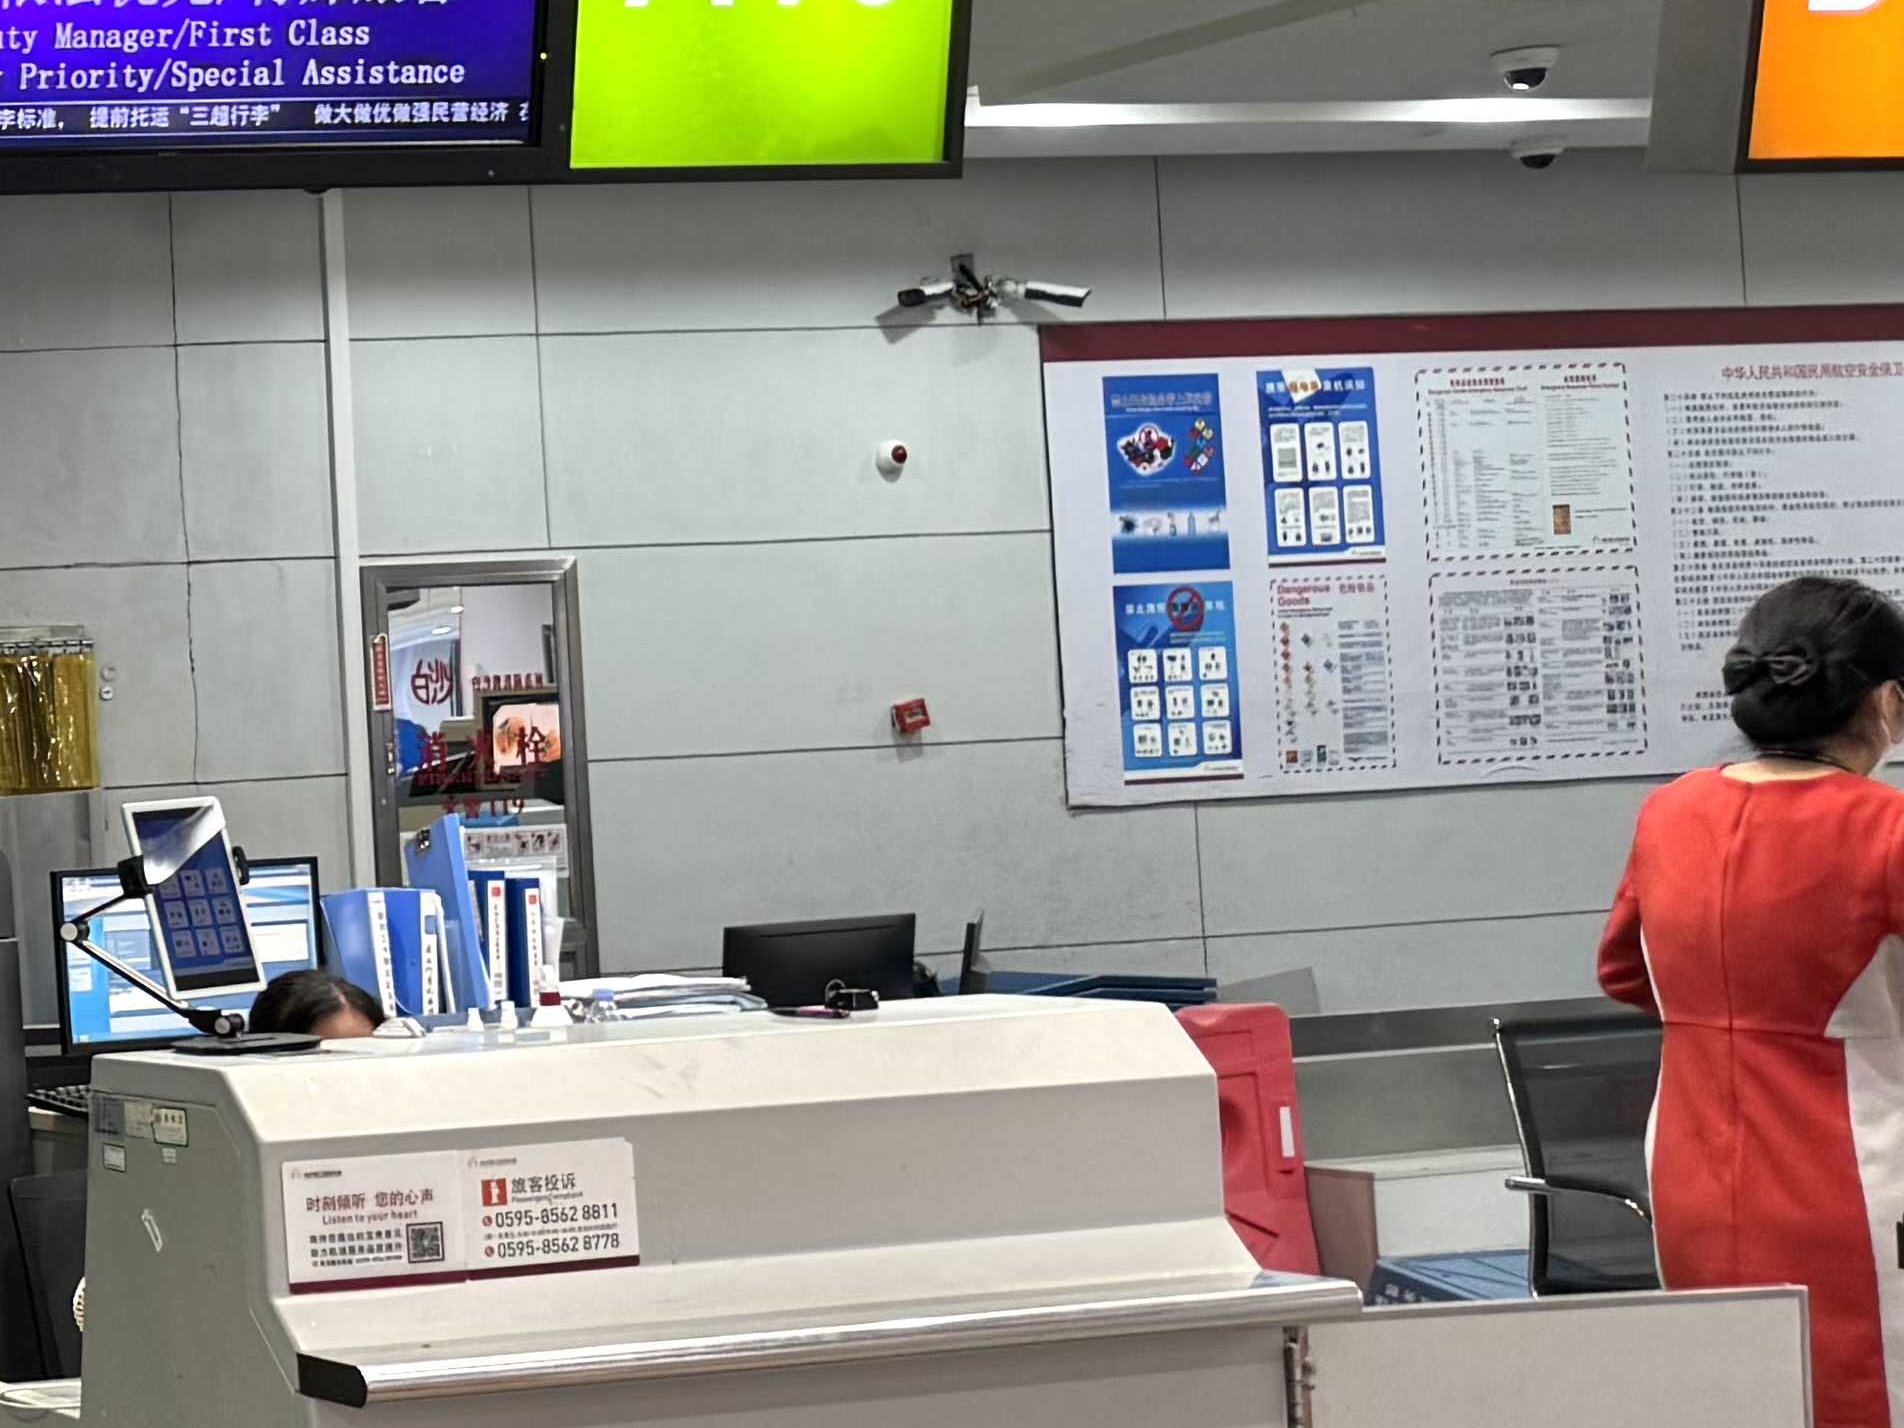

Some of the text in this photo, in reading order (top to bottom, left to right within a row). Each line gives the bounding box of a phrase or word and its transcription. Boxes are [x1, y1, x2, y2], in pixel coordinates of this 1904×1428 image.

[54, 18, 272, 53] Manager/First
[288, 18, 370, 47] Class
[19, 57, 285, 94] Priority/Special
[301, 58, 465, 86] Assistance
[511, 1172, 577, 1194] 旅客投诉
[305, 1188, 434, 1213] 时刻倾听 您的心声
[495, 1203, 619, 1228] 0595-8562 8811
[497, 1237, 579, 1259] 0595-8562
[582, 1232, 620, 1251] 8778
